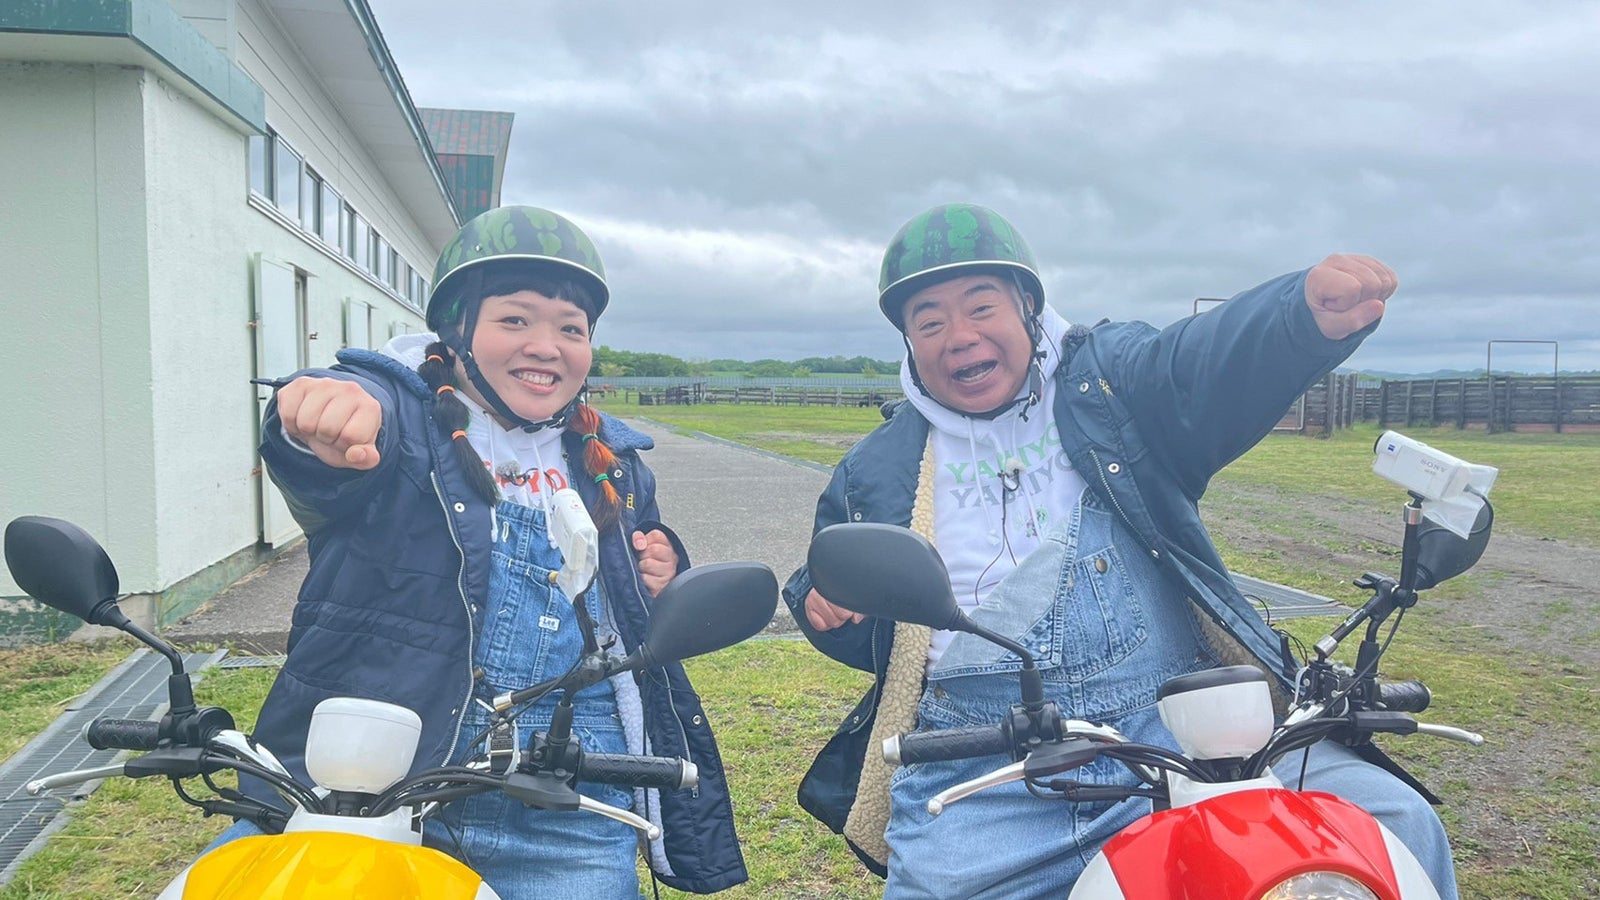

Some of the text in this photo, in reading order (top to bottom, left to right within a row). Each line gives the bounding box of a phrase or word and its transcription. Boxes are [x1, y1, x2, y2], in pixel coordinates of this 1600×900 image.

[944, 421, 1061, 484] YAIYO
[1420, 458, 1449, 473] SONY
[542, 617, 556, 627] Lee
